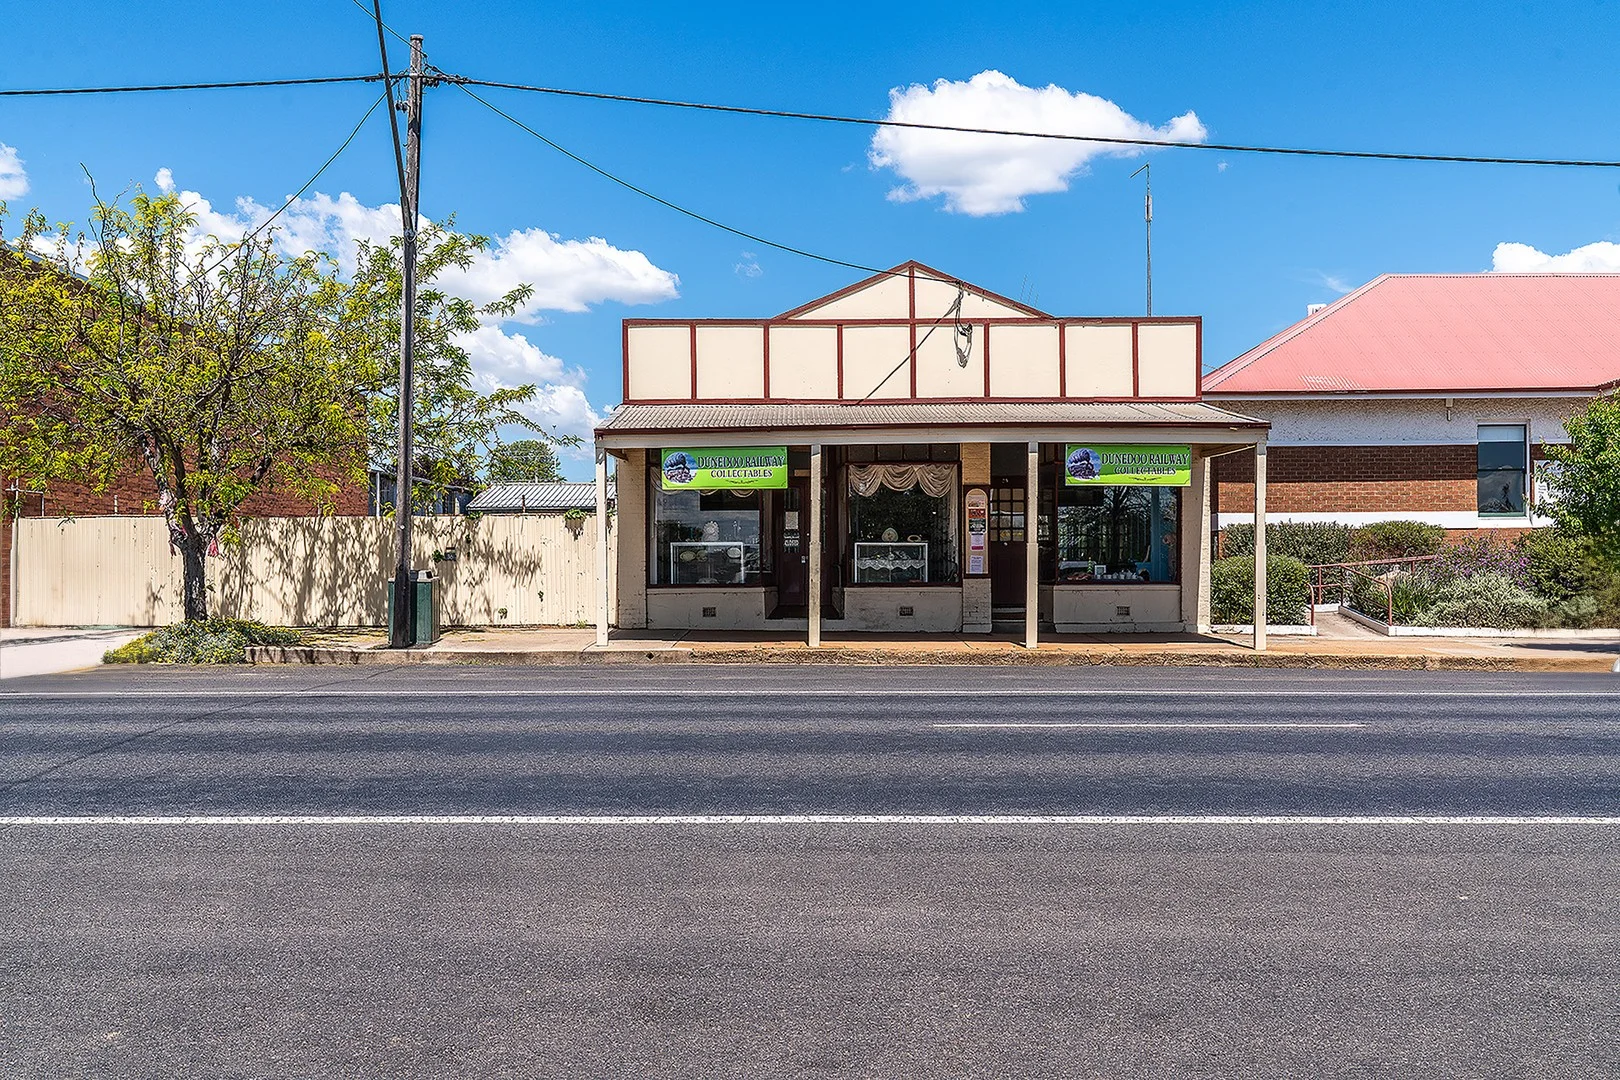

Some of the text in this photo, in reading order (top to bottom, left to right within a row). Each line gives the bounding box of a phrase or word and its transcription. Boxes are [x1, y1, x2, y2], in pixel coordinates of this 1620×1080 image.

[697, 456, 785, 468] DUNEDOO RAILWAY
[1101, 453, 1189, 465] DUNEDOO RAILWAY
[710, 469, 773, 478] COLLECTABLES
[1114, 466, 1176, 475] COLLECTABLES
